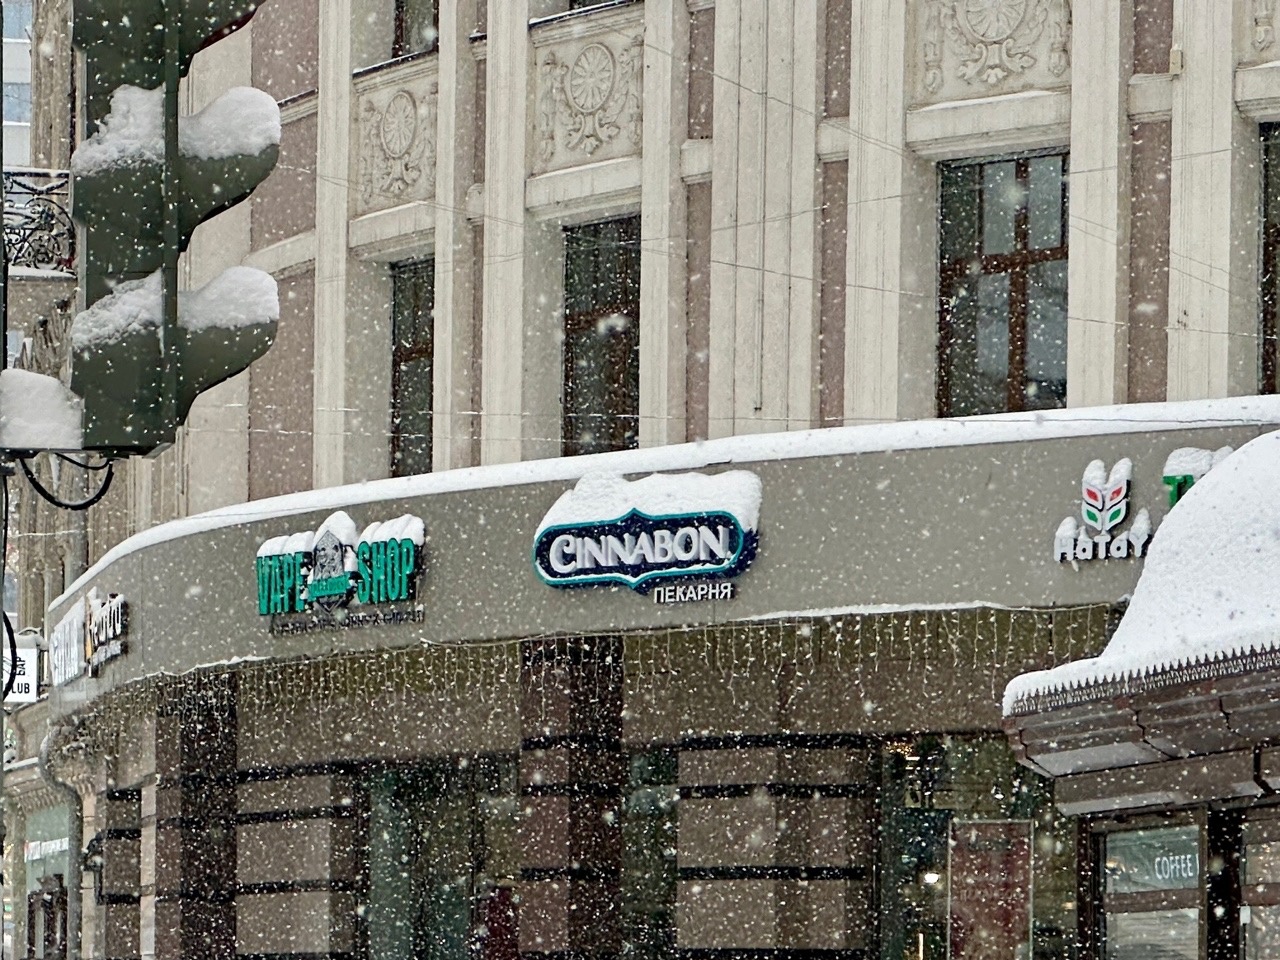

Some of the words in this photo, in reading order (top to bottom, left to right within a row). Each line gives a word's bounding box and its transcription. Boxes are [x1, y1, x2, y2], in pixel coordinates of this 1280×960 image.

[550, 525, 731, 574] CINNABON
[257, 551, 306, 616] VAPE
[357, 538, 415, 604] SHOP
[654, 582, 732, 604] ПЕКАРНЯ
[11, 682, 30, 694] LUB
[1155, 855, 1194, 879] COFFEE
